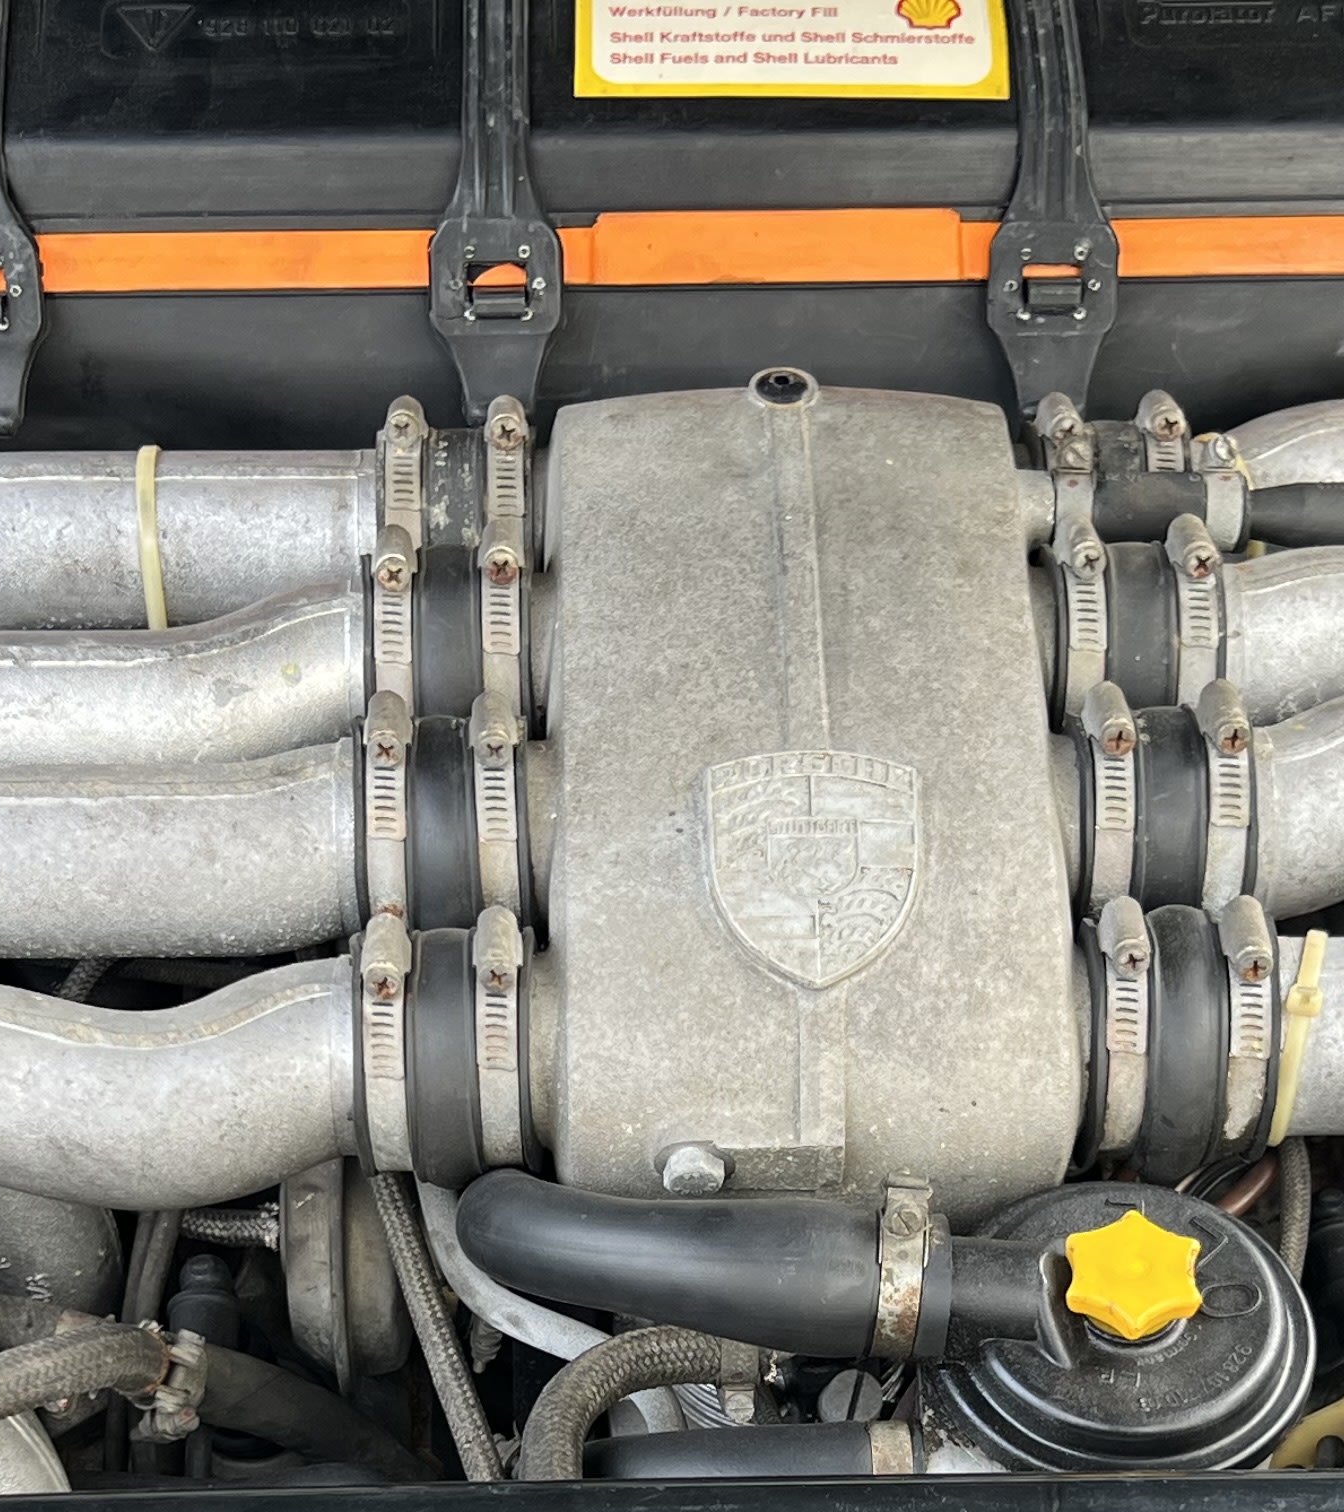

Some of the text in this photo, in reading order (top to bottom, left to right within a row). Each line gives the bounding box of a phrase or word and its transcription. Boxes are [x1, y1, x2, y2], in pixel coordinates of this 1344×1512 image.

[608, 6, 717, 18] Werkfüllung
[738, 6, 805, 19] Factory
[811, 7, 838, 17] Fill
[610, 31, 975, 45] Shell Kraftstoffe und Shell Schmierstoffe
[610, 52, 898, 65] Shell Fuels and Shell Lubricants
[712, 753, 915, 792] PORSCHE
